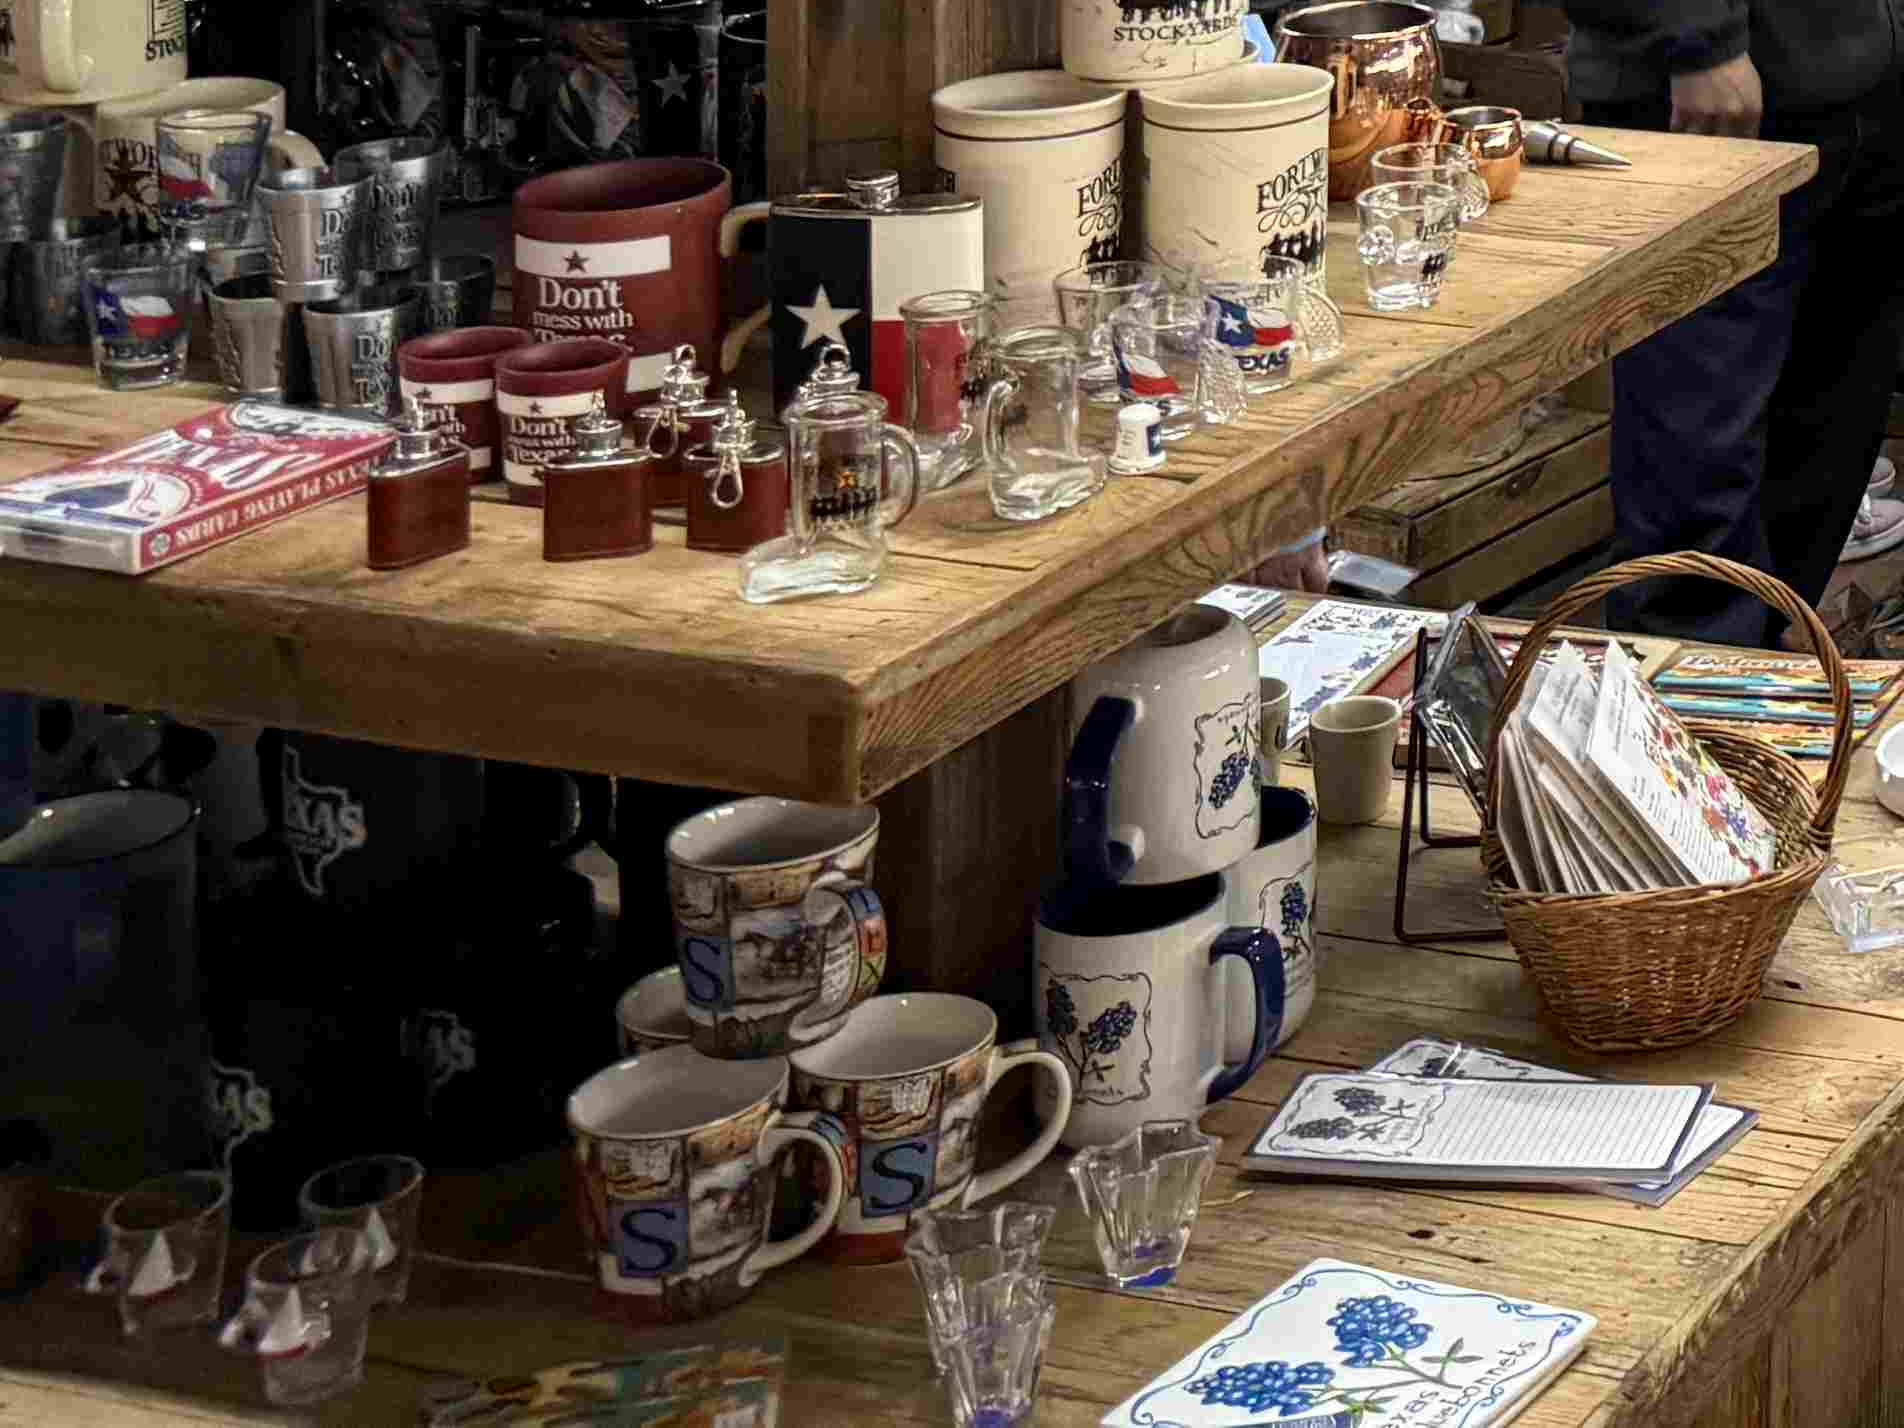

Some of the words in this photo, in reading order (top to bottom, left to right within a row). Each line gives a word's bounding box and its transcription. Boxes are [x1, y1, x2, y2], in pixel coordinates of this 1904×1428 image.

[1112, 15, 1238, 43] STOCKYARDS
[537, 277, 625, 311] Don't
[532, 310, 583, 329] mess
[584, 309, 635, 329] with
[510, 415, 569, 437] Don't
[247, 480, 322, 523] PLAYING
[176, 513, 240, 543] CARDS
[684, 937, 722, 1002] S
[868, 1142, 927, 1210] S
[619, 1208, 678, 1273] S
